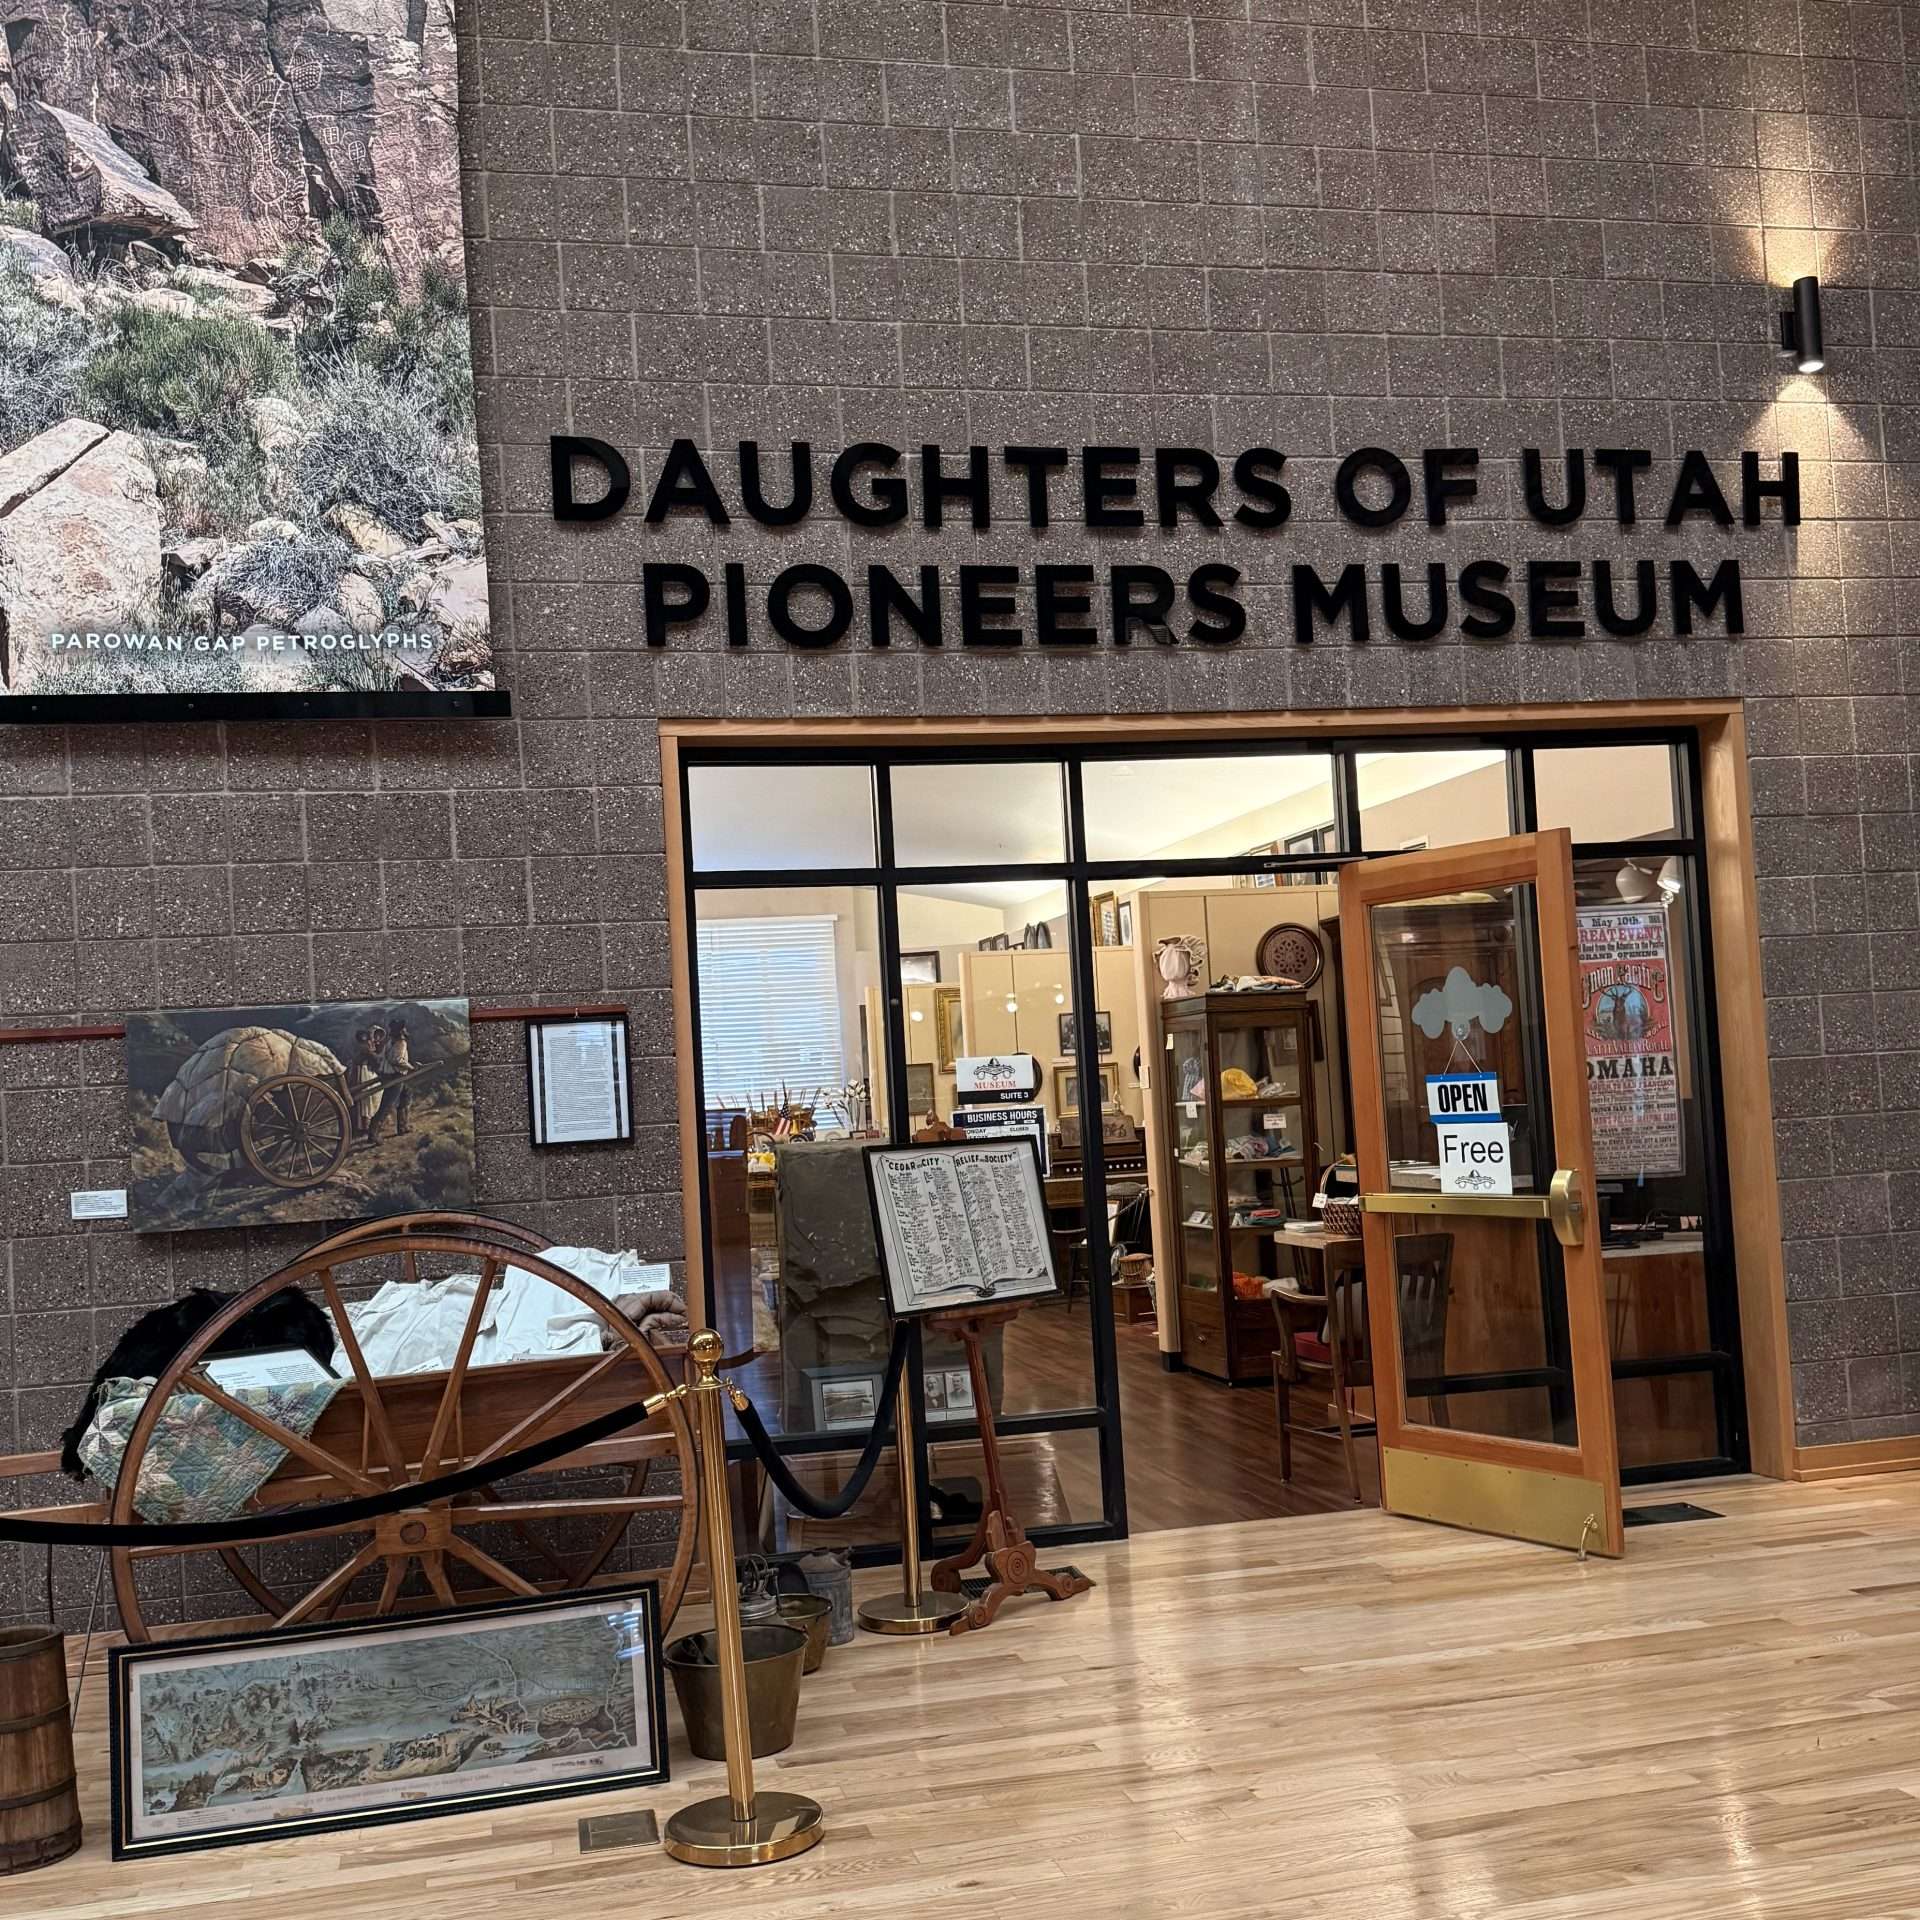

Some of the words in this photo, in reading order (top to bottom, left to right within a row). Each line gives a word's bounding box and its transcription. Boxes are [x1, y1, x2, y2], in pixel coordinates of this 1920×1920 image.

[550, 435, 1291, 530] DAUGHTERS
[1337, 447, 1480, 529] OF
[1522, 449, 1801, 526] UTAH
[643, 562, 1247, 648] PIONEERS
[1292, 559, 1745, 643] MUSEUM
[51, 632, 183, 651] PAROWAN
[193, 635, 246, 652] GAP
[256, 632, 434, 651] PETROGLYPHS
[1592, 917, 1613, 928] May
[1580, 929, 1617, 943] REAT
[1619, 926, 1664, 943] EVENT
[1617, 950, 1659, 959] OPENING
[974, 1080, 1017, 1089] MUSEUM
[1000, 1091, 1022, 1100] SUITE
[1437, 1083, 1489, 1113] OPEN
[967, 1111, 1008, 1123] BUSINESS
[1009, 1110, 1038, 1121] HOURS
[1443, 1134, 1505, 1164] Free
[921, 1157, 940, 1167] CITY
[955, 1155, 979, 1167] RELIEF
